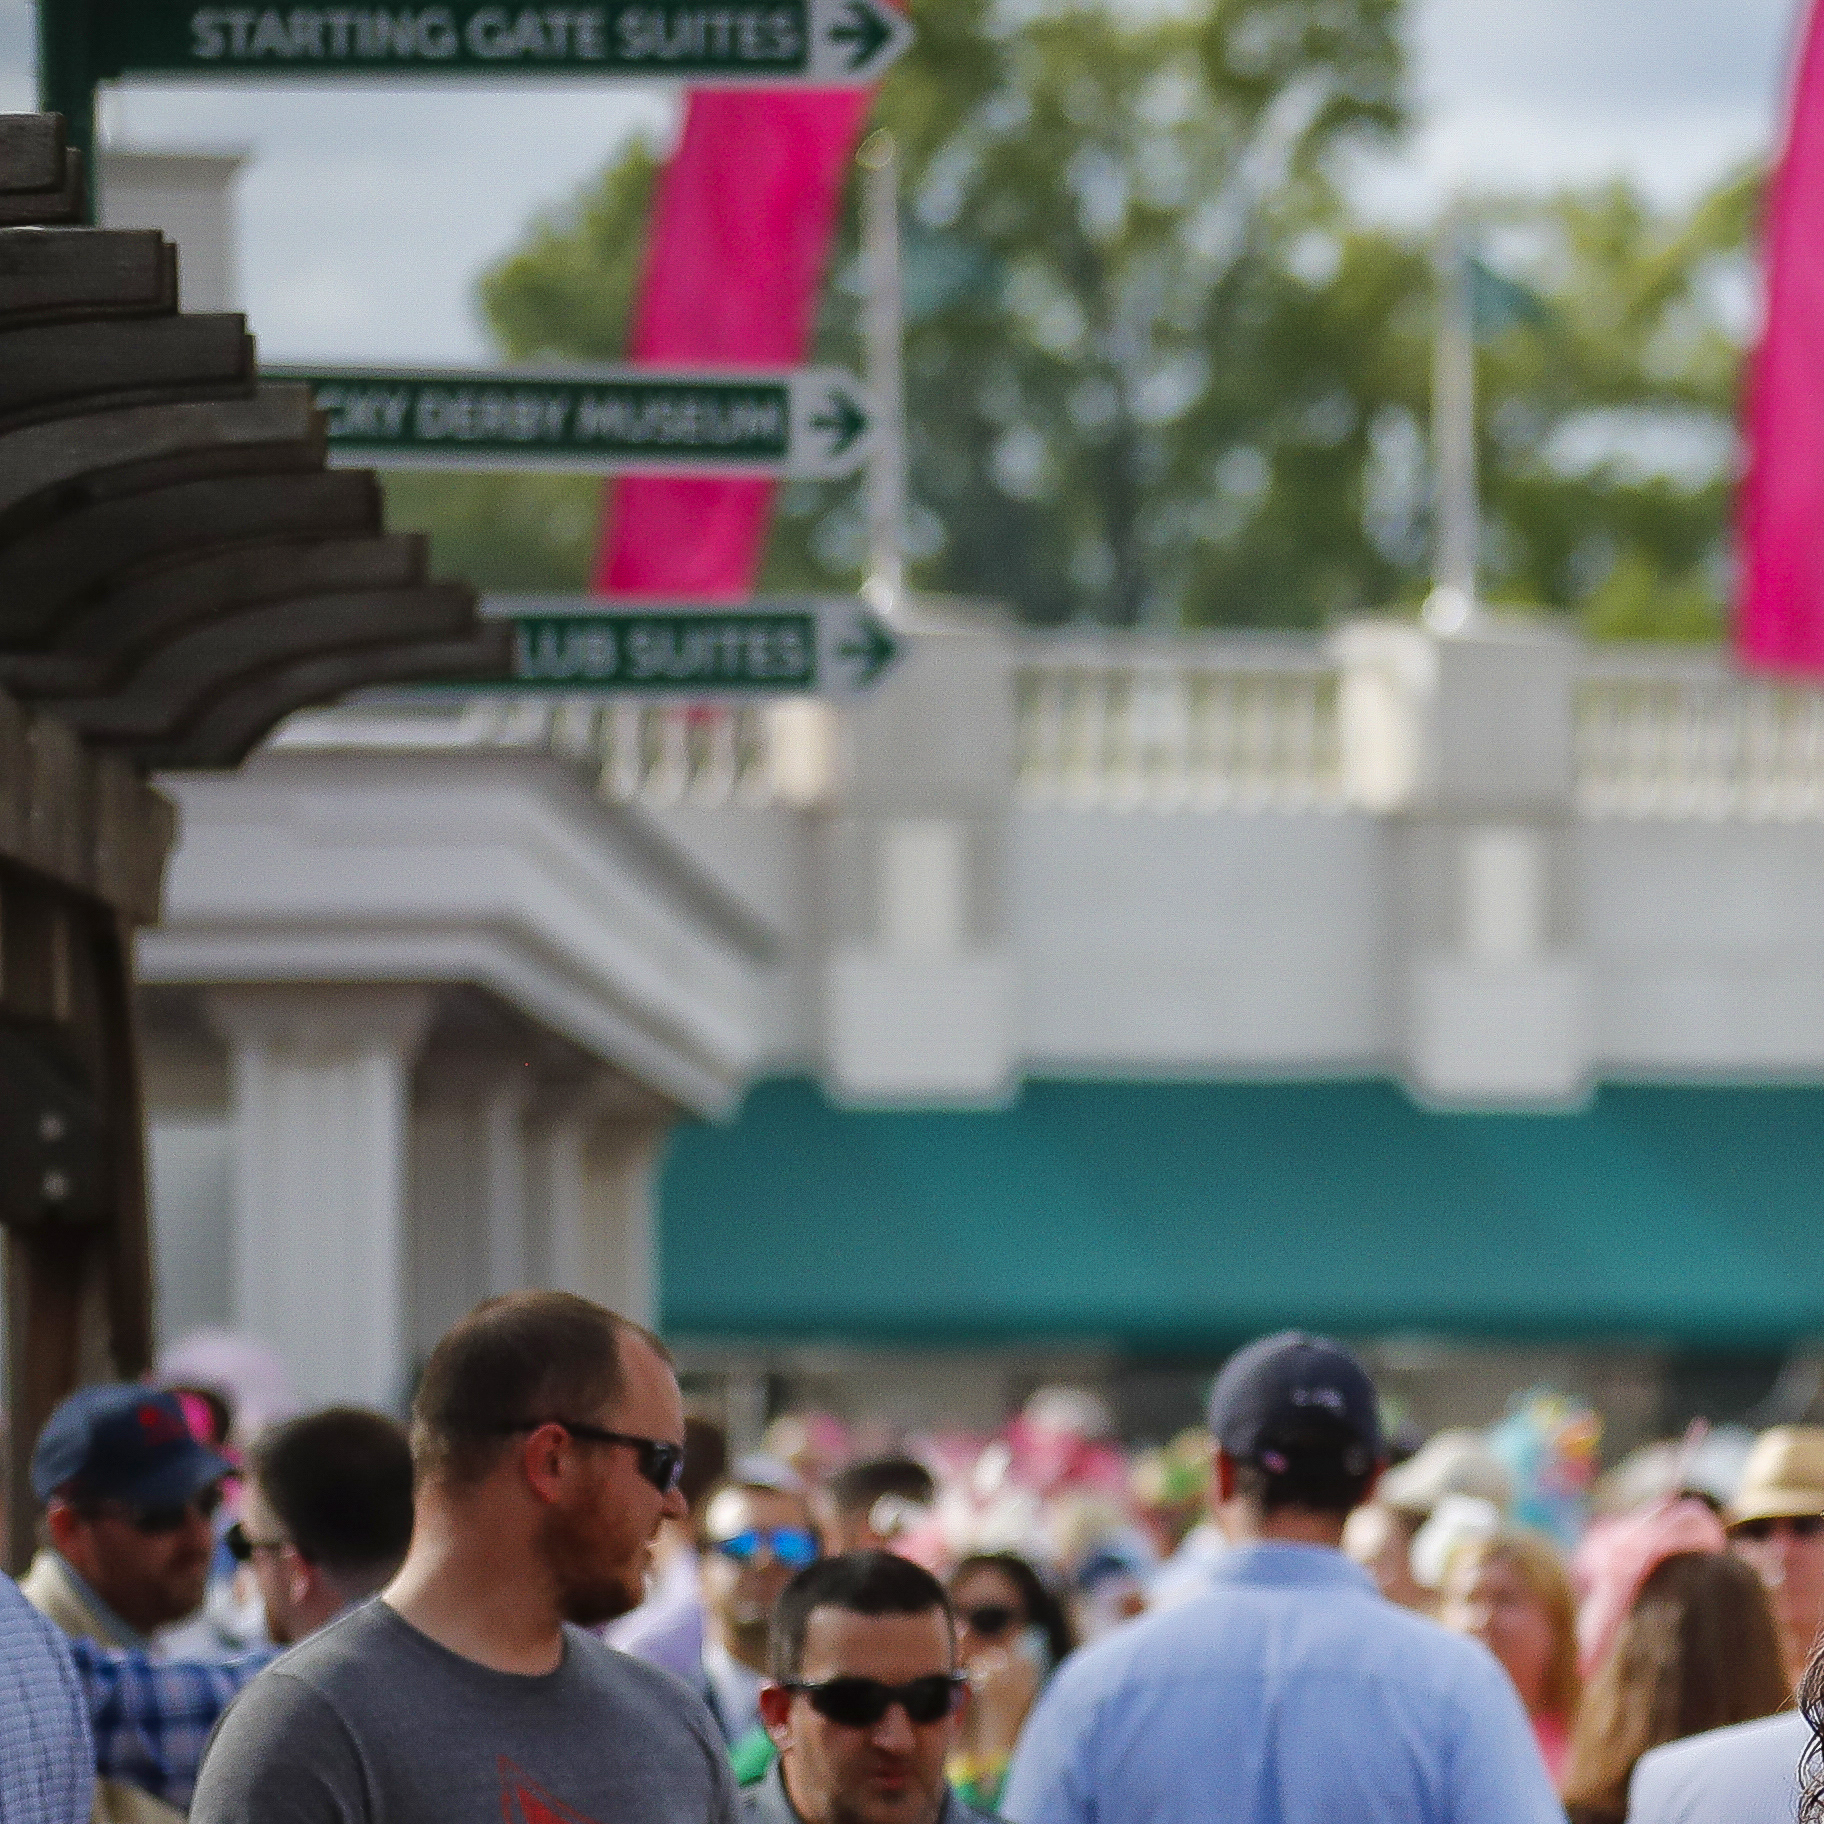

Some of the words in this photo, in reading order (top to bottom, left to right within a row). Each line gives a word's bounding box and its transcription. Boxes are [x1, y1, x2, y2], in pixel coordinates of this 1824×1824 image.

[188, 4, 457, 60] STARTING
[464, 4, 606, 60] GATE
[616, 5, 801, 61] SUITES
[414, 386, 574, 443] DERBY
[575, 390, 784, 446] MUSEUM
[626, 622, 803, 681] SUITES
